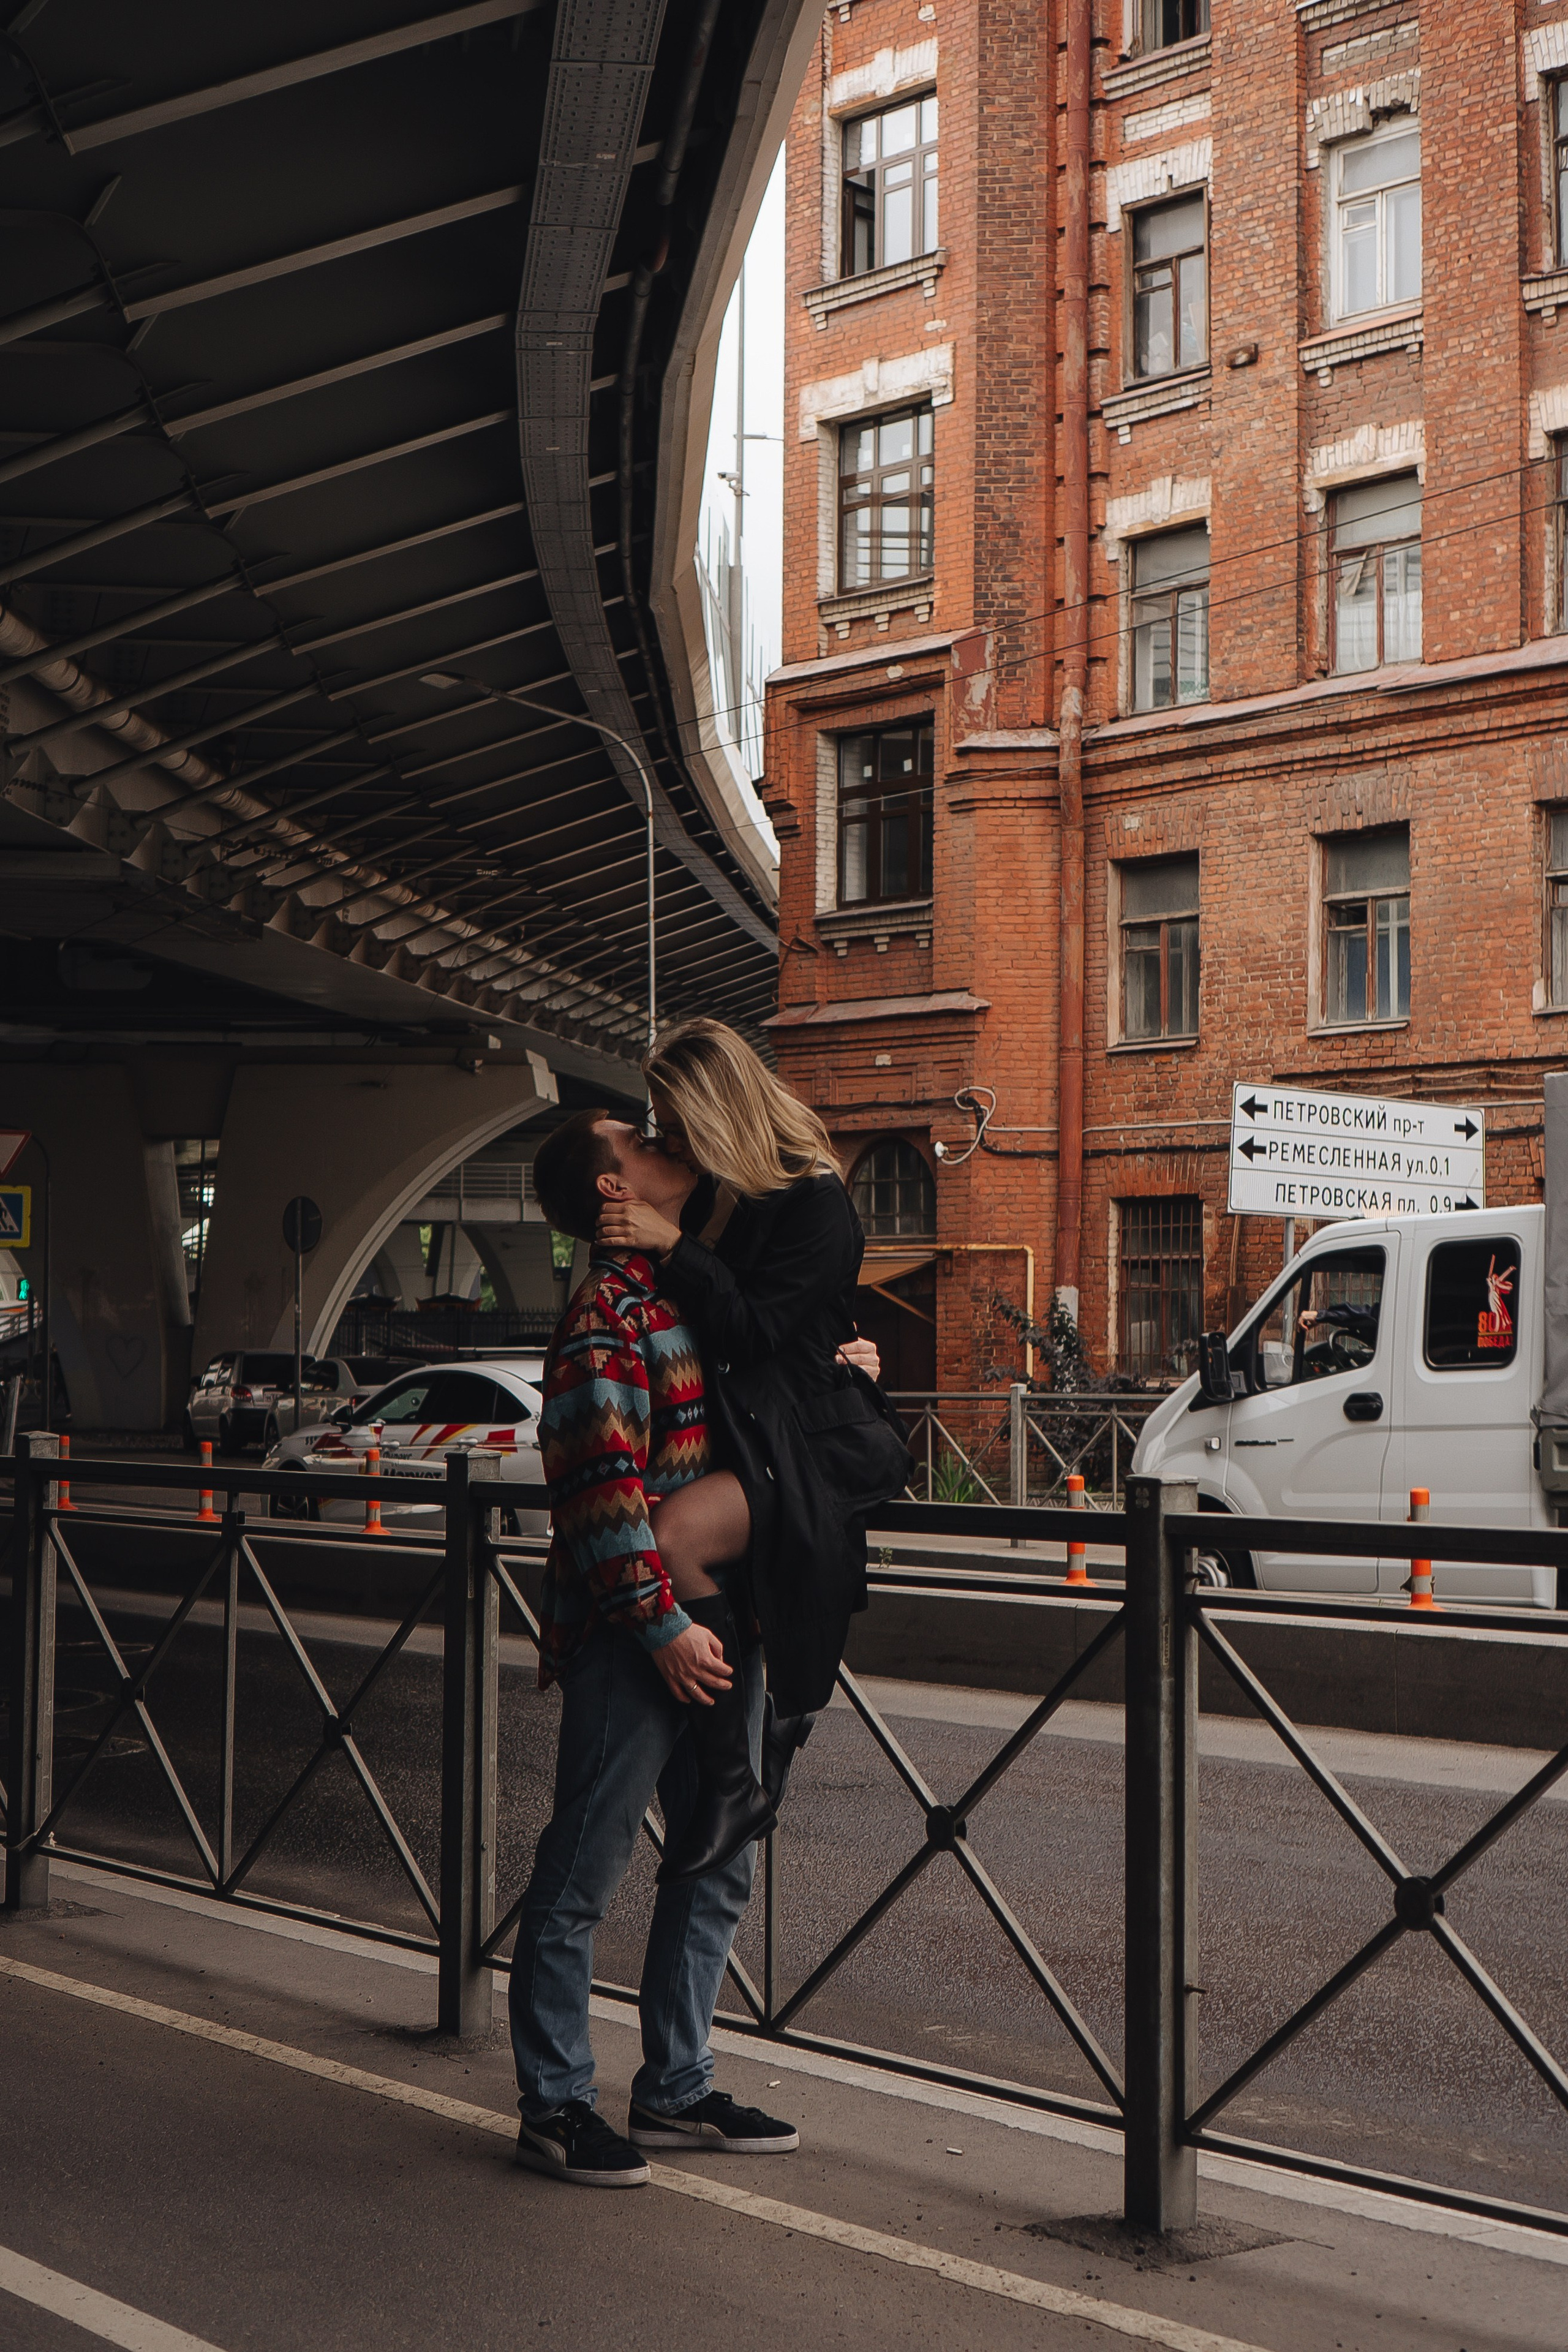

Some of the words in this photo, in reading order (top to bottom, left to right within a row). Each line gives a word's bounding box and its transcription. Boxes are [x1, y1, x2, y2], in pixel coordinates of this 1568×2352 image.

[1273, 1100, 1387, 1131] ПЕТРОВСКИЙ
[1393, 1118, 1425, 1137] пр-т
[1269, 1141, 1401, 1171] РЕМЕСЛЕННАЯ
[1275, 1183, 1391, 1210] ПЕТРОВСКАЯ
[1398, 1198, 1420, 1213] пл.
